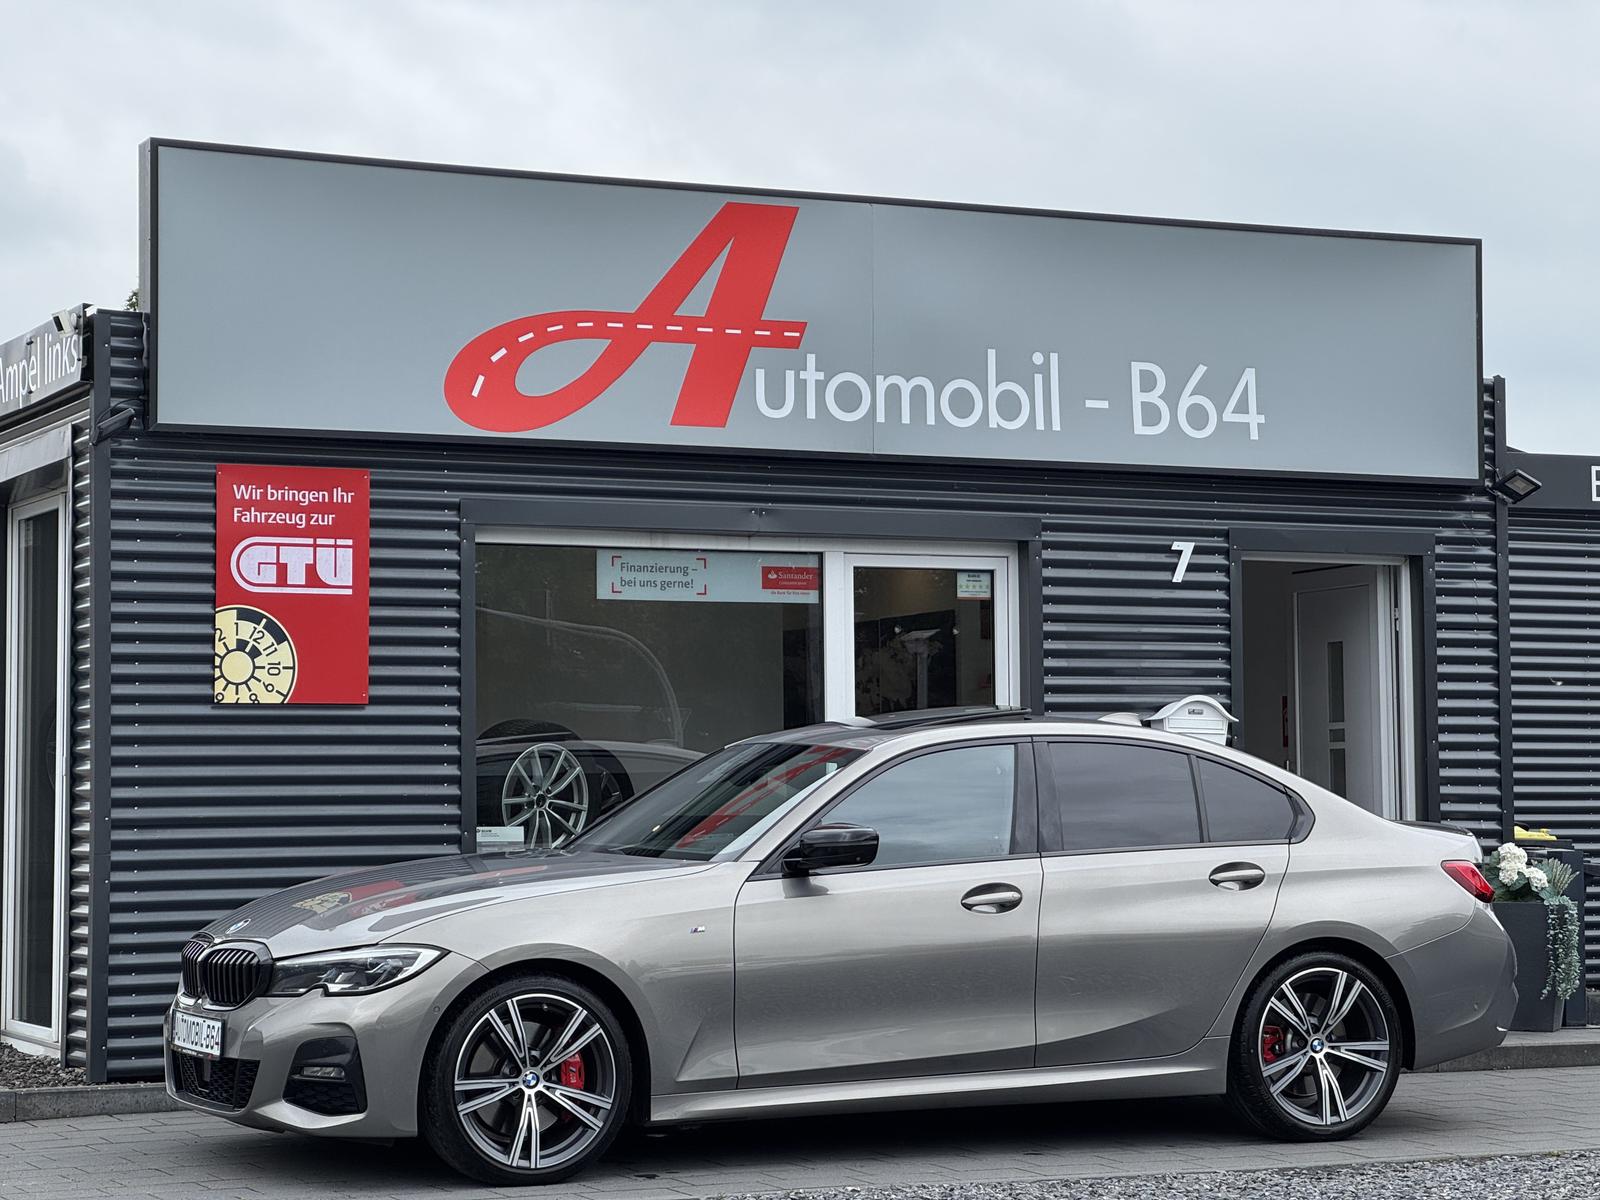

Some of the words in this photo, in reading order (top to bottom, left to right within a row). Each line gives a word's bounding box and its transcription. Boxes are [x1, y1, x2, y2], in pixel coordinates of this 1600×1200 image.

[443, 201, 1062, 433] Automobil
[1085, 399, 1109, 409] -
[1130, 361, 1266, 441] B64
[44, 332, 79, 385] links
[233, 484, 263, 500] Wir
[267, 485, 328, 505] bringen
[333, 487, 354, 503] Ihr
[233, 507, 306, 528] Fahrzeug
[310, 513, 335, 525] zur
[230, 536, 353, 594] GTÜ
[620, 562, 689, 577] Finanzierung
[1171, 541, 1195, 582] 7
[620, 576, 636, 588] bei
[639, 580, 658, 588] uns
[660, 579, 694, 591] gerne!
[778, 571, 813, 580] Santander
[234, 622, 239, 636] 1
[249, 626, 265, 645] 12
[263, 642, 278, 656] 11
[267, 661, 281, 676] 10
